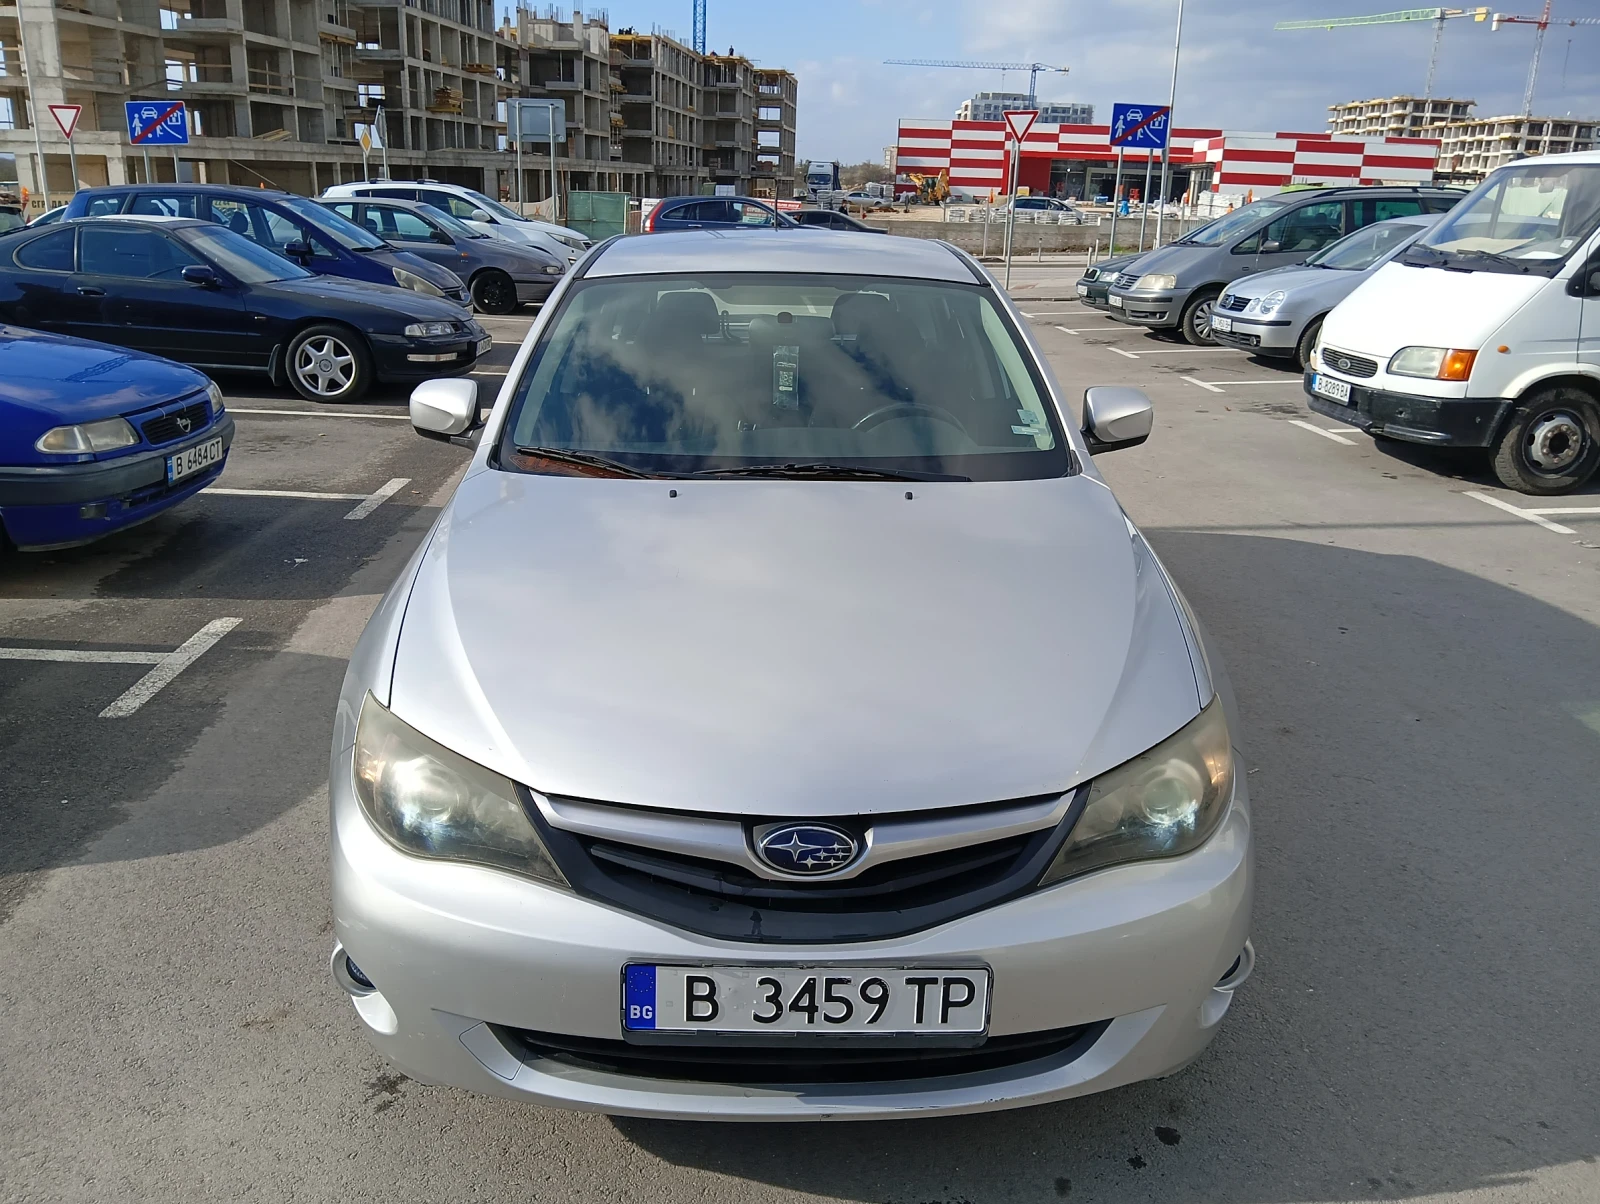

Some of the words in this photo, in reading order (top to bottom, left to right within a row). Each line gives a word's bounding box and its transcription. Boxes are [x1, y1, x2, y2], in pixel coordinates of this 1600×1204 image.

[31, 200, 63, 209] СГРДА
[176, 456, 183, 475] B
[187, 445, 208, 470] 6484
[209, 440, 220, 461] CT
[630, 1004, 653, 1020] BG
[685, 975, 720, 1022] B
[752, 977, 891, 1025] 3459
[904, 977, 977, 1024] TP
